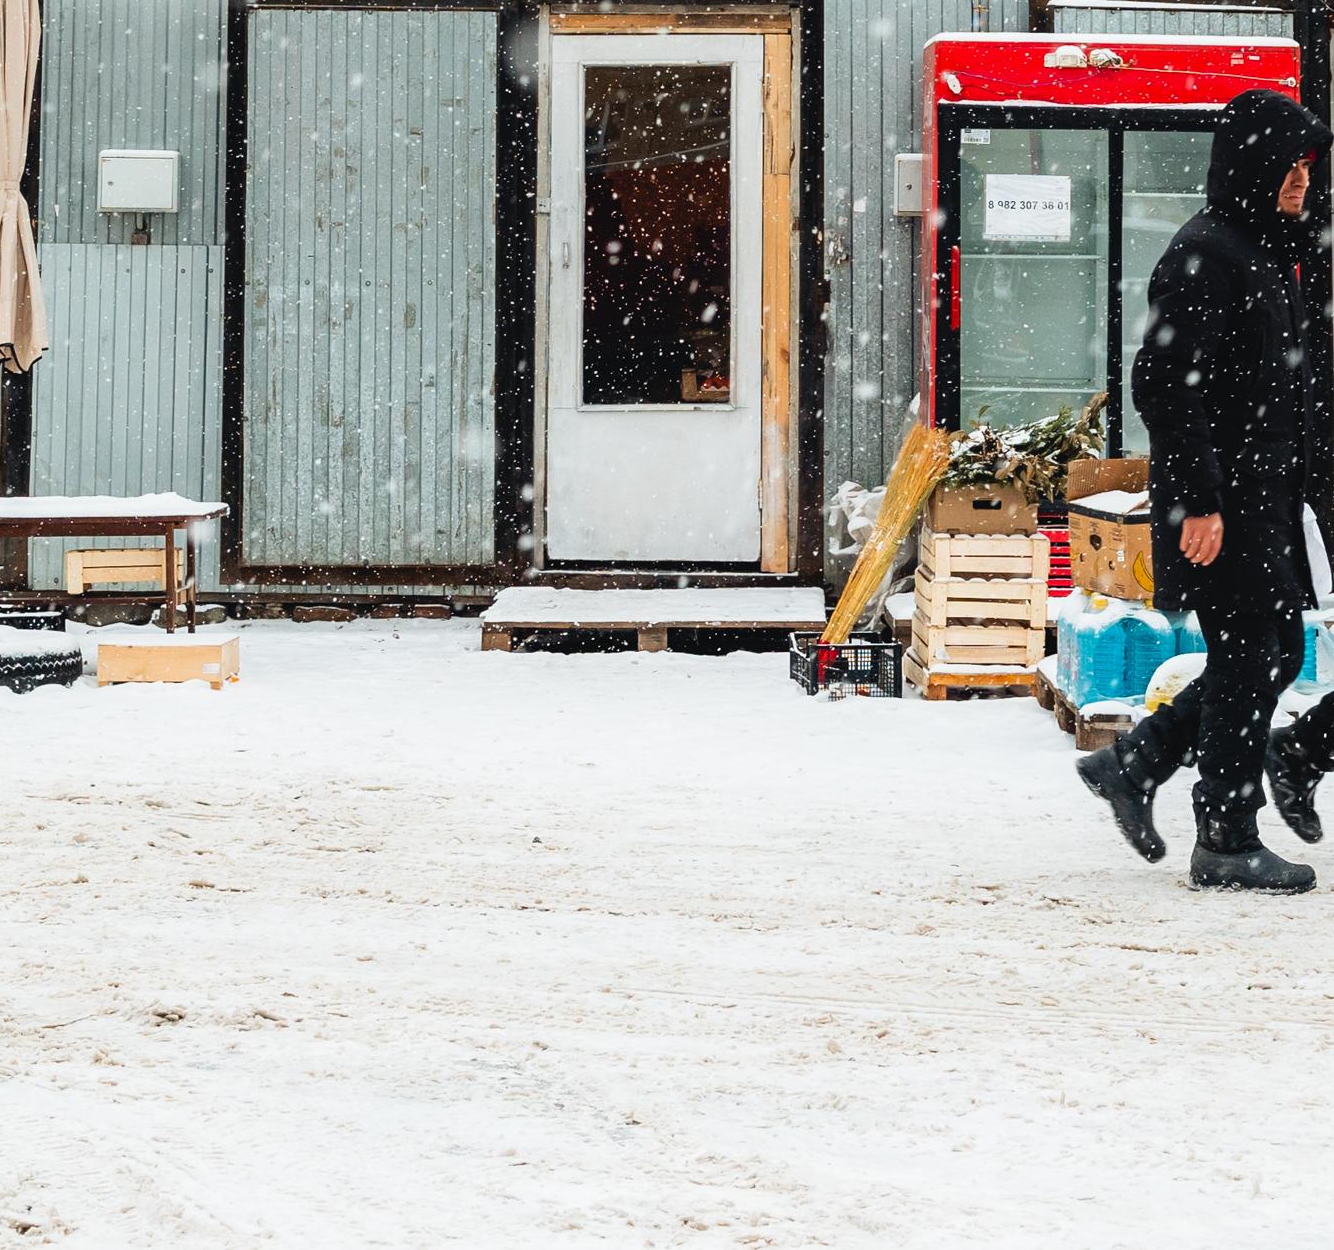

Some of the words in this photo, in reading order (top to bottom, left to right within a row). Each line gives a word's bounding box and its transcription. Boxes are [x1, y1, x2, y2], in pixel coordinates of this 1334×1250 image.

[988, 200, 994, 209] 8
[998, 200, 1016, 209] 982
[1020, 201, 1038, 210] 307
